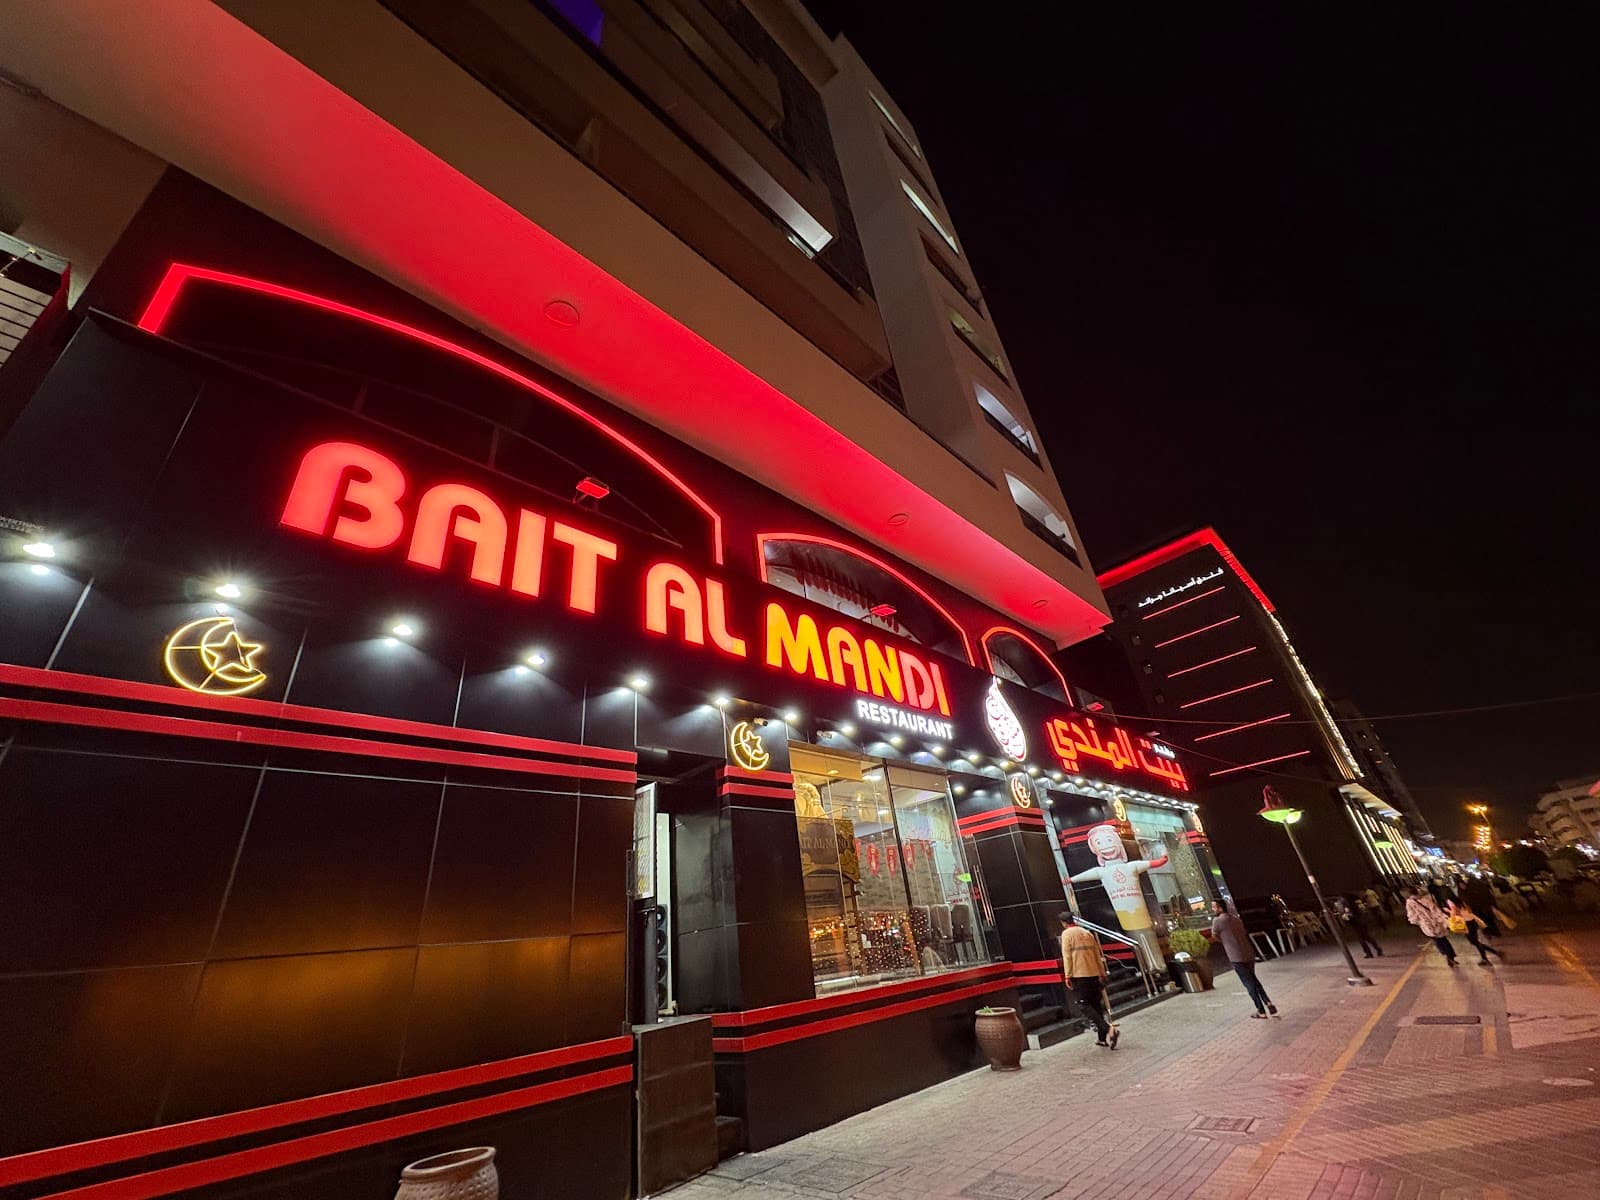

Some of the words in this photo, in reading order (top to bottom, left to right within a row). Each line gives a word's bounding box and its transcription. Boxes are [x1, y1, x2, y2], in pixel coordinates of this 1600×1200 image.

[279, 440, 618, 614] BAIT
[644, 562, 747, 657] AL
[765, 602, 951, 717] MANDI
[856, 699, 953, 740] RESTAURANT
[1046, 717, 1140, 772] المندي
[1137, 738, 1190, 791] بيت
